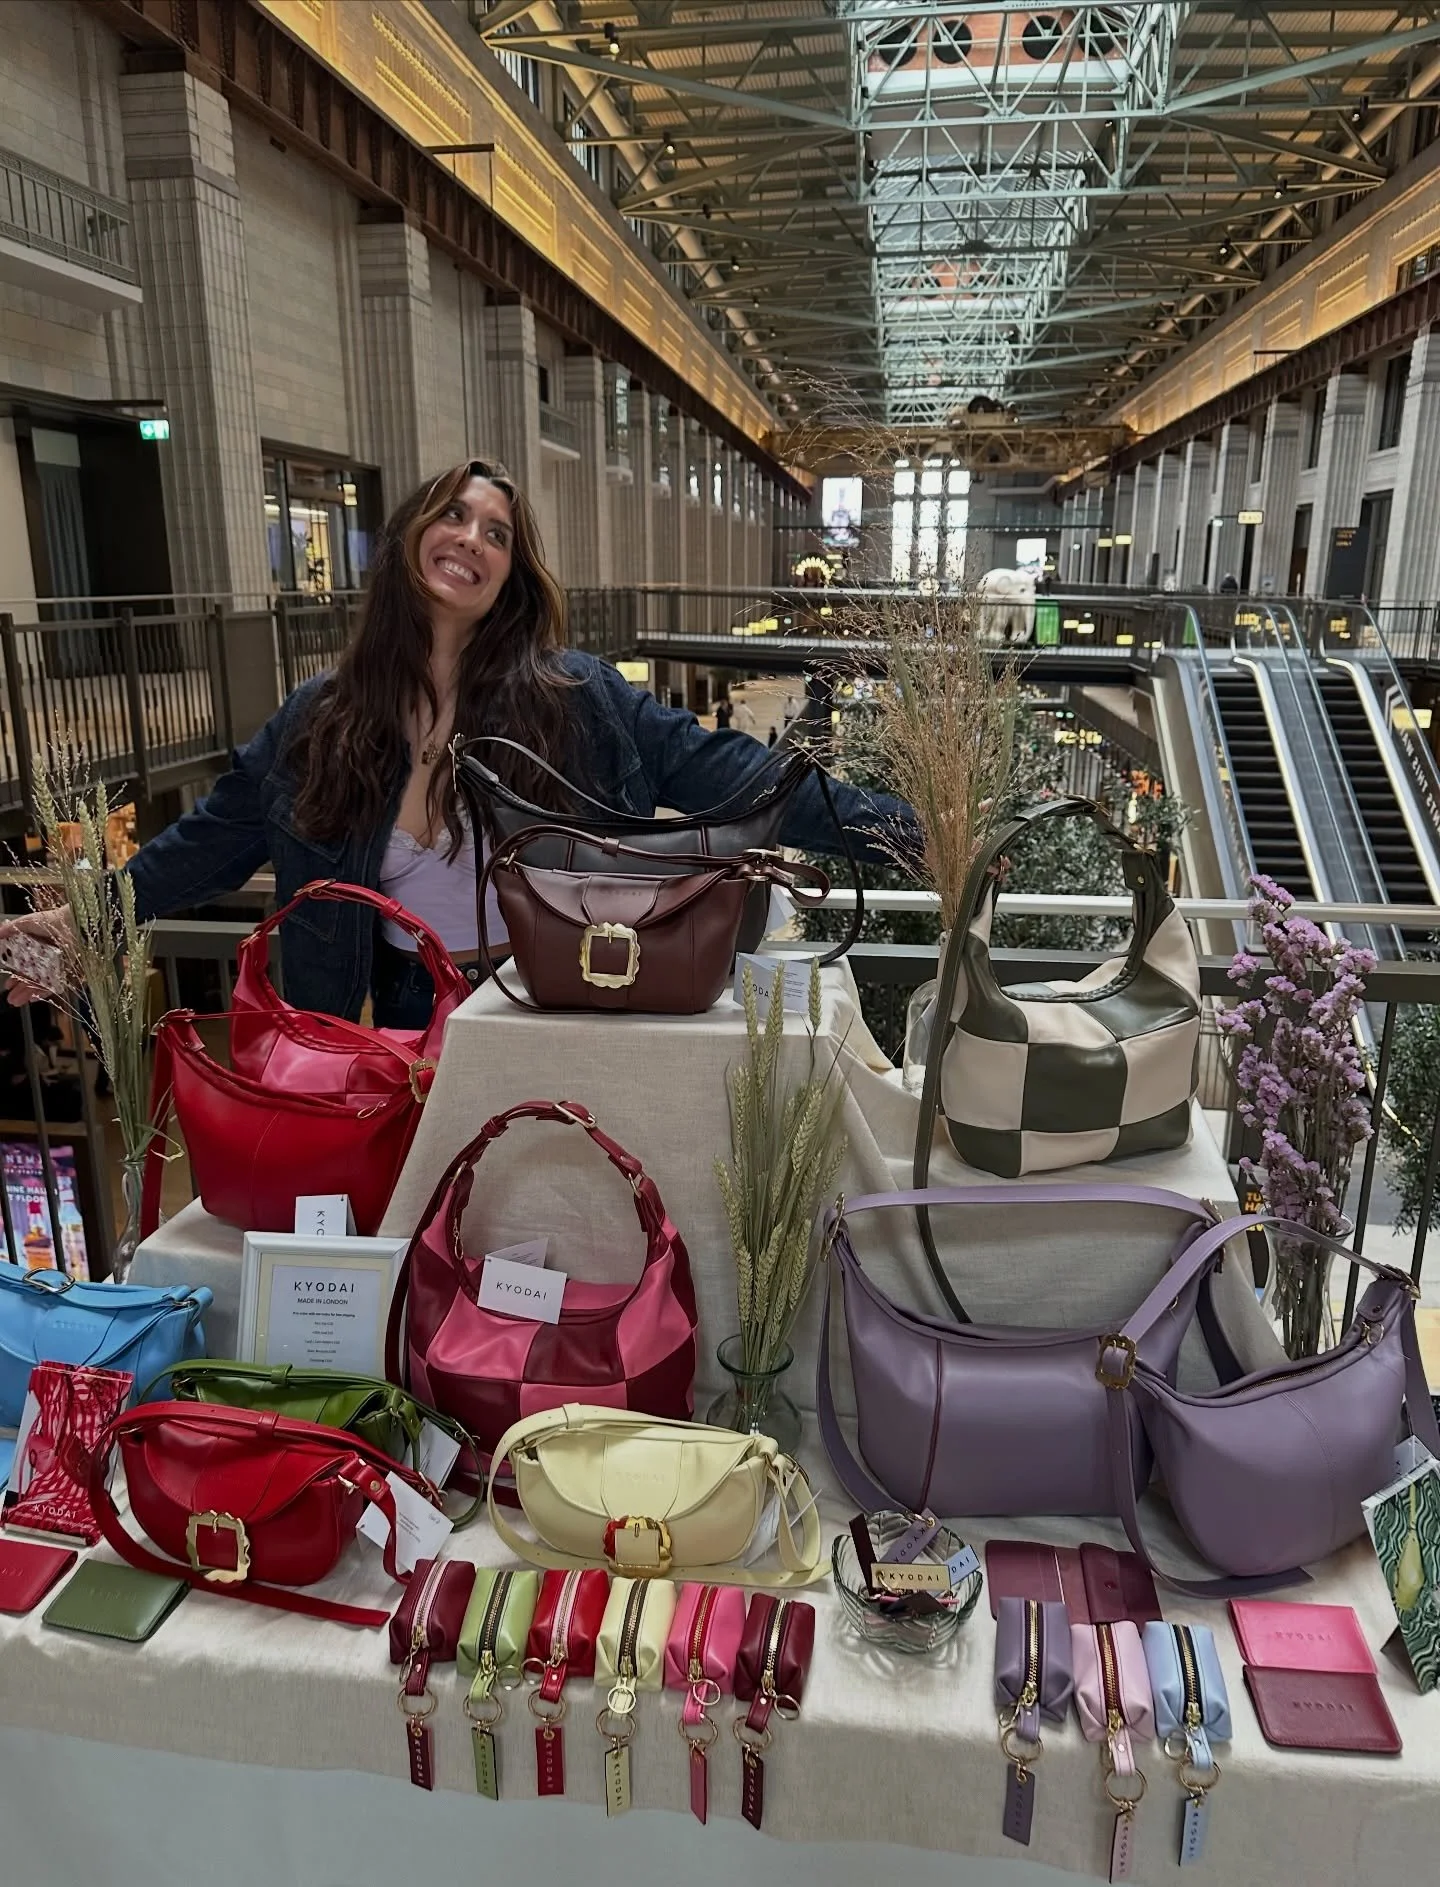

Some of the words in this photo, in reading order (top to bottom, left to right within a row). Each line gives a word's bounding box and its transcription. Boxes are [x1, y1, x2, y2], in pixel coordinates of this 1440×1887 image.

[316, 1211, 325, 1236] KYO
[294, 1281, 354, 1293] KYODAI
[496, 1281, 547, 1301] KYODAI
[34, 1503, 77, 1519] KYODAI
[893, 1527, 926, 1562] KYODA
[951, 1556, 970, 1573] DAI
[889, 1573, 940, 1582] KYODAI
[1275, 1631, 1332, 1641] KYODAI
[1292, 1701, 1354, 1713] KYODAI
[414, 1738, 425, 1784] KYODAI
[545, 1742, 554, 1789] KYODAI
[613, 1763, 623, 1807] KYODAI
